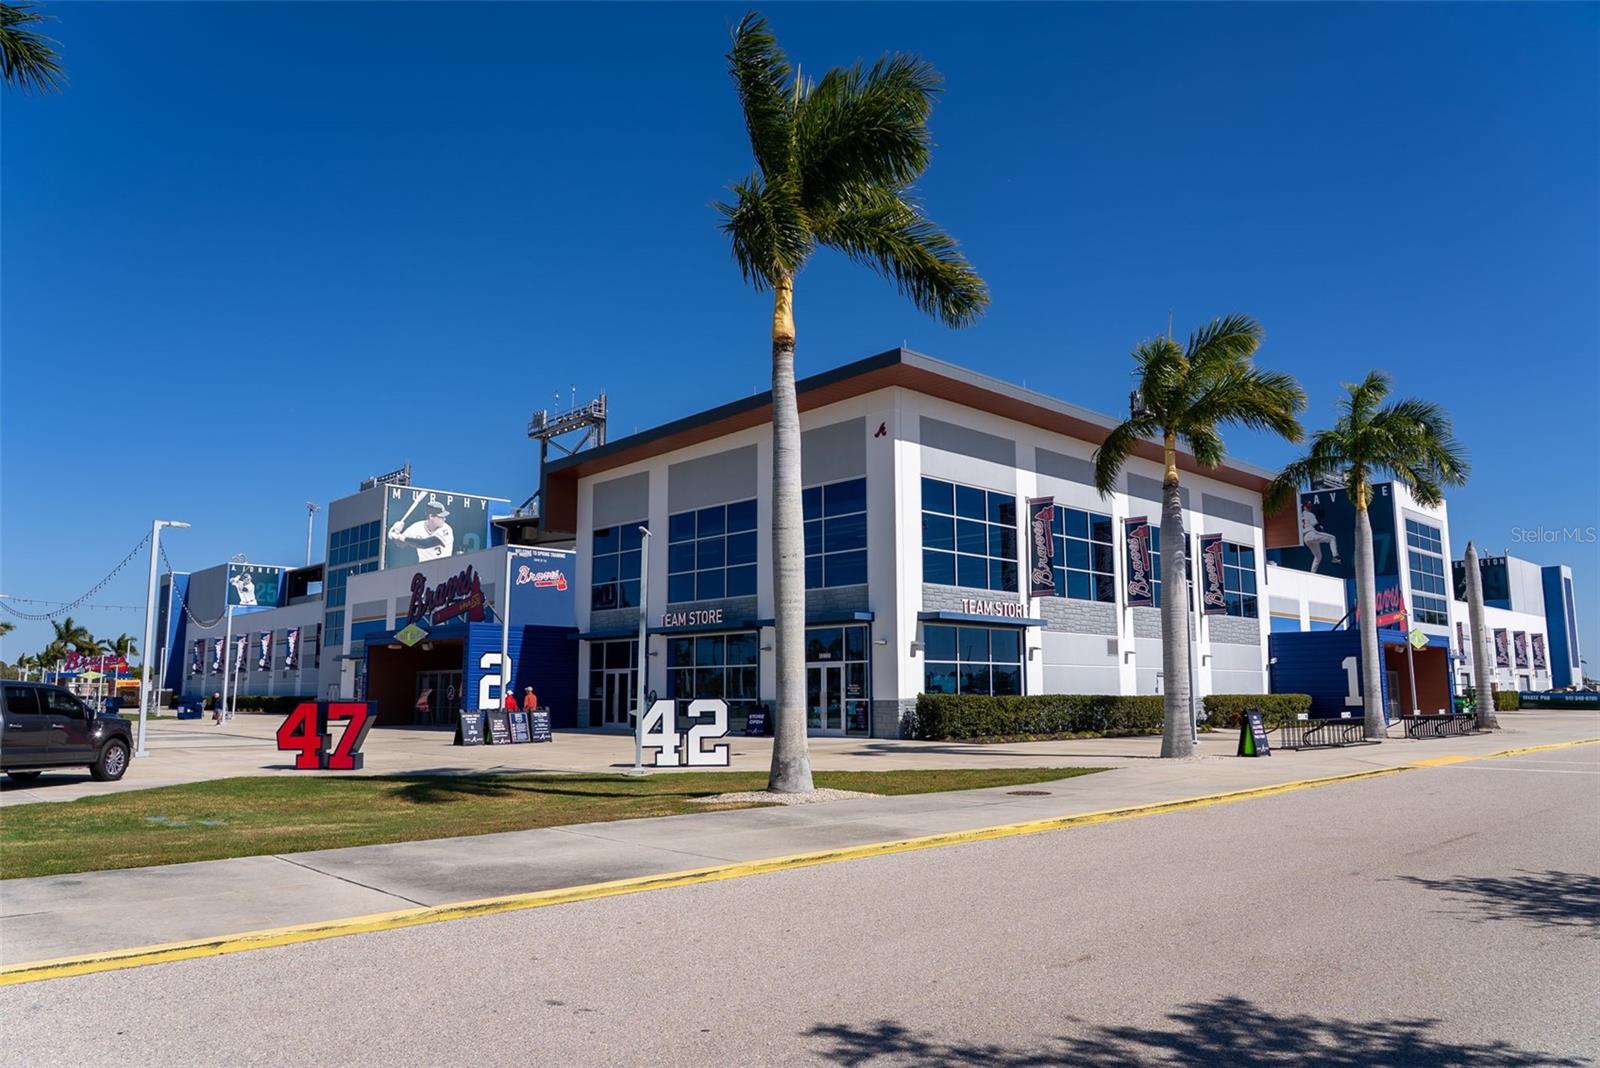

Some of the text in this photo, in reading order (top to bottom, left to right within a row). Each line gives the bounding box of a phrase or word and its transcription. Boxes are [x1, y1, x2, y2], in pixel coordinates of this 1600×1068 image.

[392, 488, 487, 510] MURPHY
[516, 565, 560, 585] Braves
[1032, 520, 1055, 587] Braves
[1127, 537, 1151, 598] Braves
[1202, 552, 1226, 608] Braves
[407, 564, 474, 626] Braves
[660, 608, 724, 628] TEAM STORE
[961, 599, 993, 616] TEAM
[478, 652, 512, 710] 2
[1341, 656, 1364, 707] 1
[276, 701, 372, 770] 47
[636, 698, 730, 767] 42
